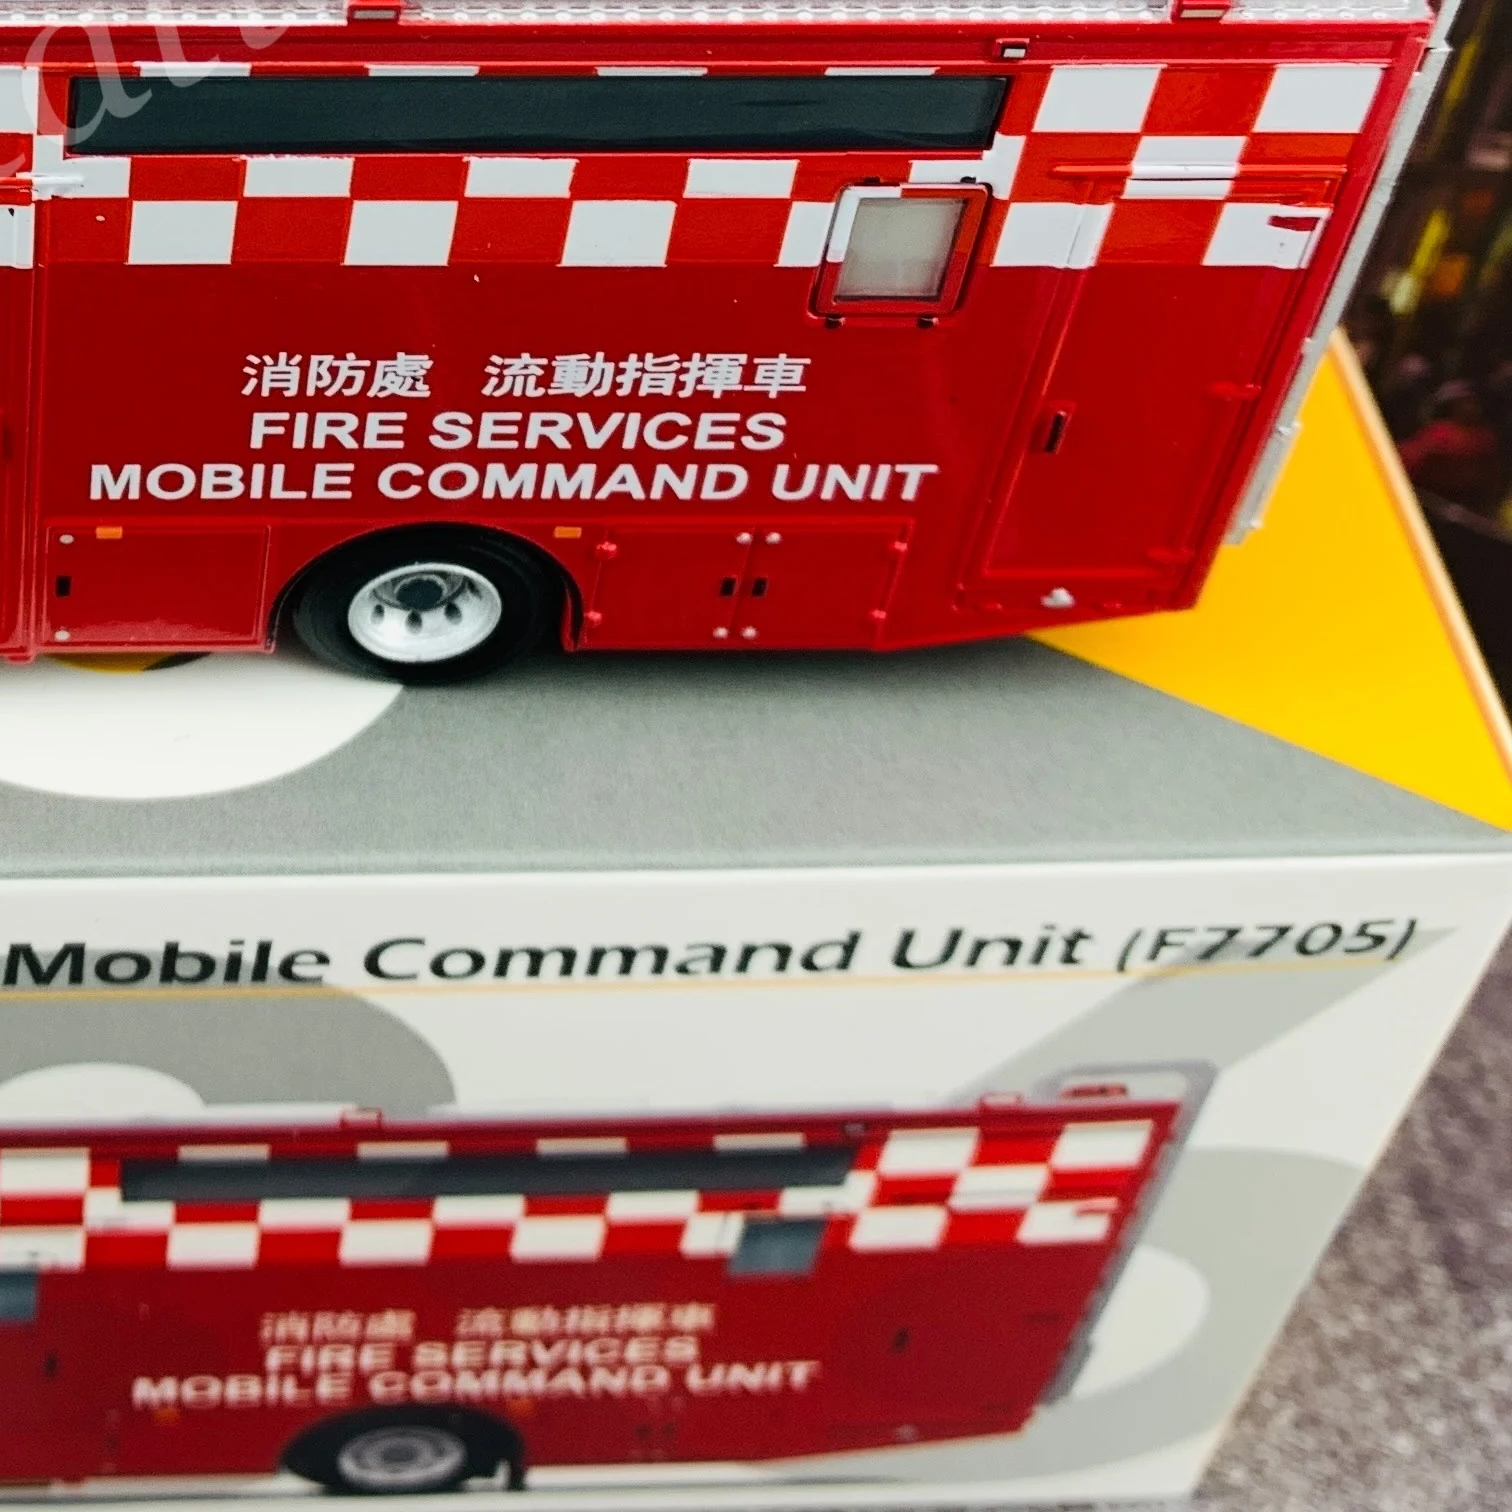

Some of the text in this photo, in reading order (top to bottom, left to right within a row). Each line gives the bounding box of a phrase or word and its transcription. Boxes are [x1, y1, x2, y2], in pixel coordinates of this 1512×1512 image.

[242, 351, 811, 399] 消防處 流動指揮車
[250, 411, 787, 450] FIRE SERVICES
[90, 462, 938, 501] MOBILE COMMAND UNIT
[2, 940, 330, 985] Mobile
[363, 932, 861, 980] Command
[890, 922, 1091, 968] Unit
[1116, 918, 1417, 974] (F7705)
[264, 1336, 701, 1376] FIRE SERVICES
[131, 1360, 821, 1410] MOBILE COMMAND UNIT
